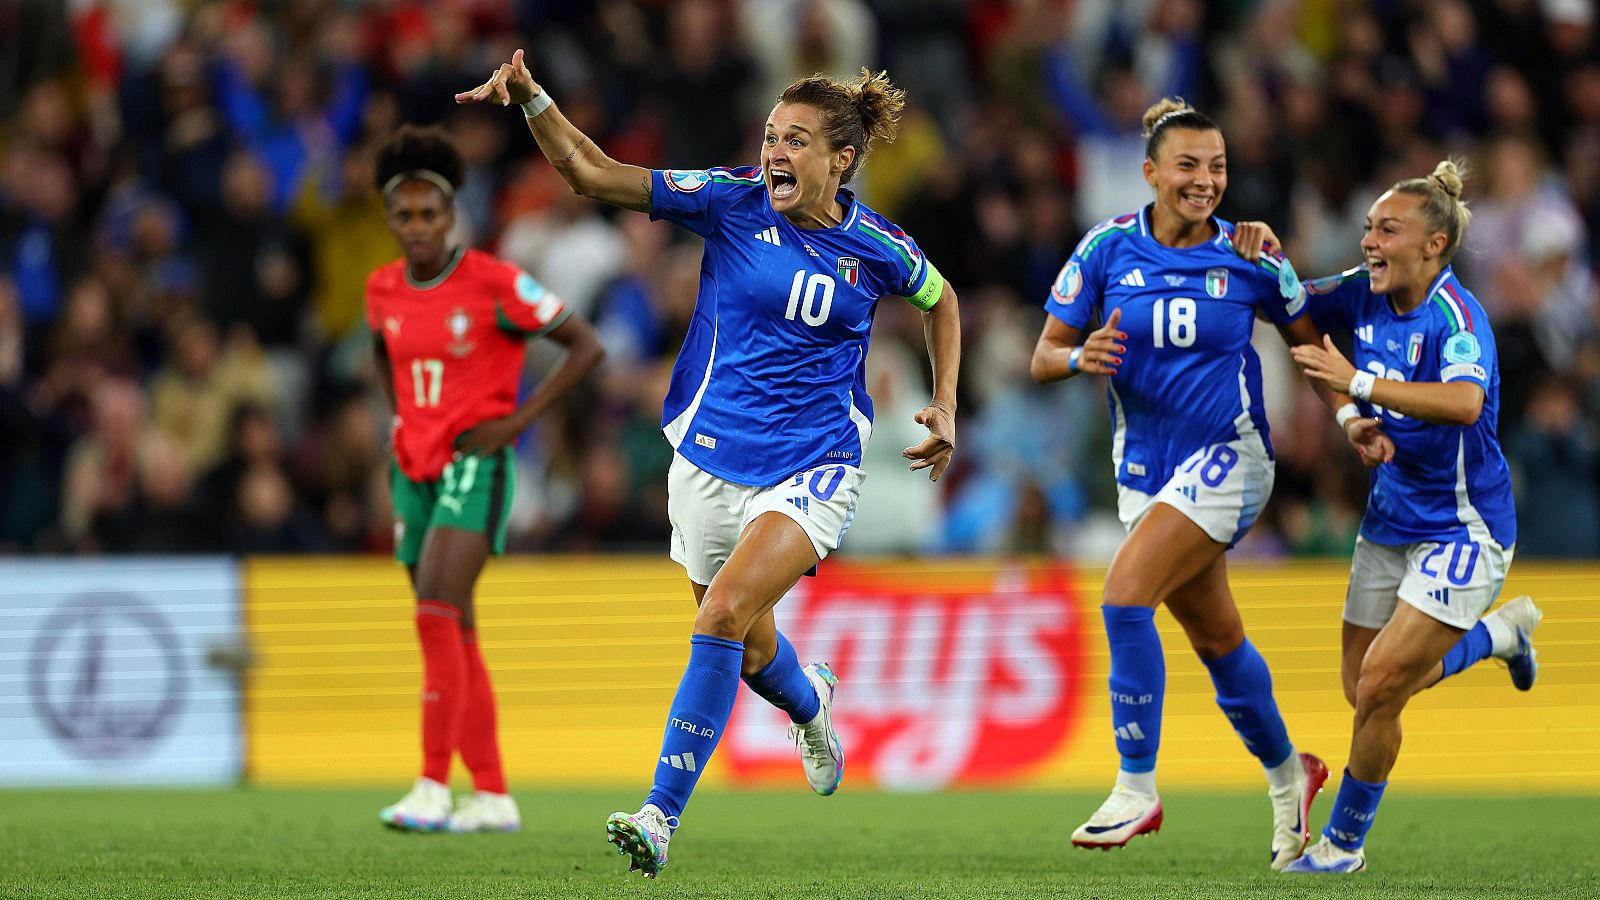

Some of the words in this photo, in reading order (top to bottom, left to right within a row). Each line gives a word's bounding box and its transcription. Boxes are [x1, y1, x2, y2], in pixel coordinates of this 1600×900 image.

[839, 259, 857, 267] ITALIA
[784, 269, 836, 328] 10
[1152, 297, 1197, 349] 18
[410, 358, 444, 408] 17
[1420, 541, 1480, 586] 20
[1110, 691, 1153, 705] ITALIA
[670, 717, 715, 740] ITALIA
